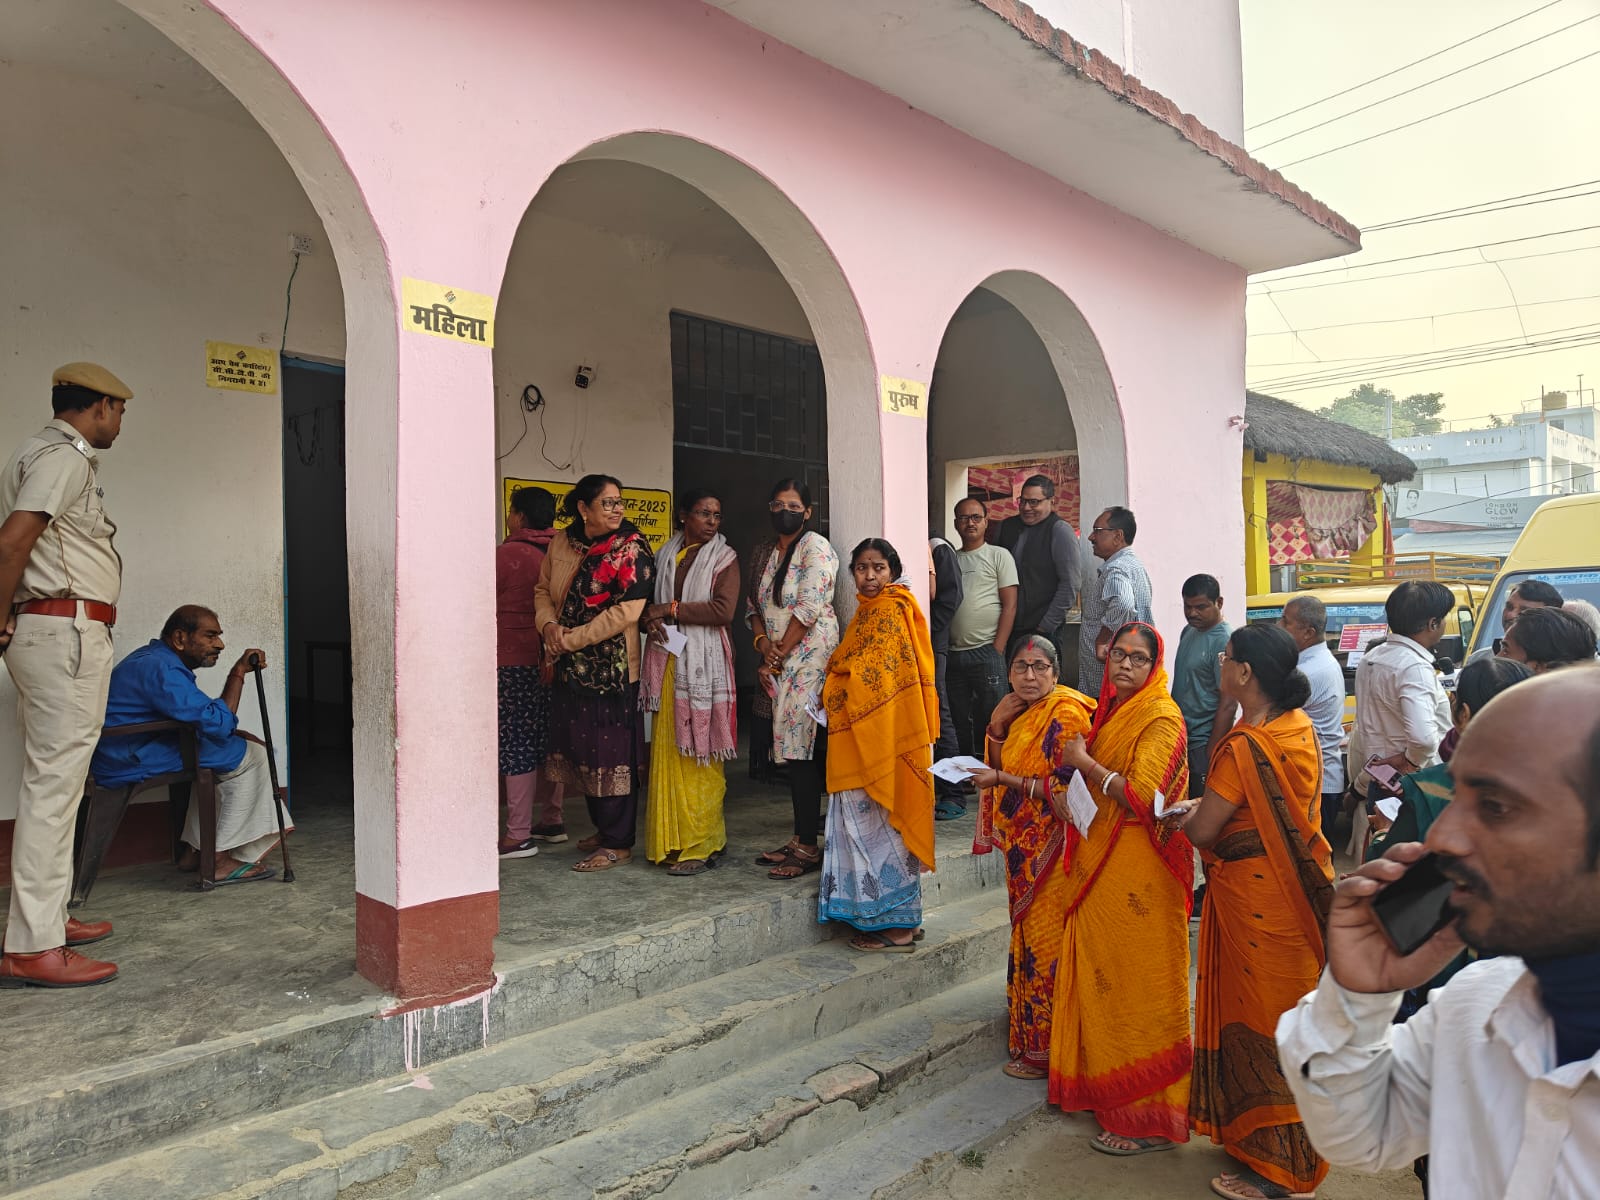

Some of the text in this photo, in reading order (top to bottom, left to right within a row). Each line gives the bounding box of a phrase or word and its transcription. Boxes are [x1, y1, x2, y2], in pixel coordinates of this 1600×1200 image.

[410, 303, 487, 341] महिला
[888, 390, 919, 412] पुरुष
[1485, 507, 1518, 516] GLOW
